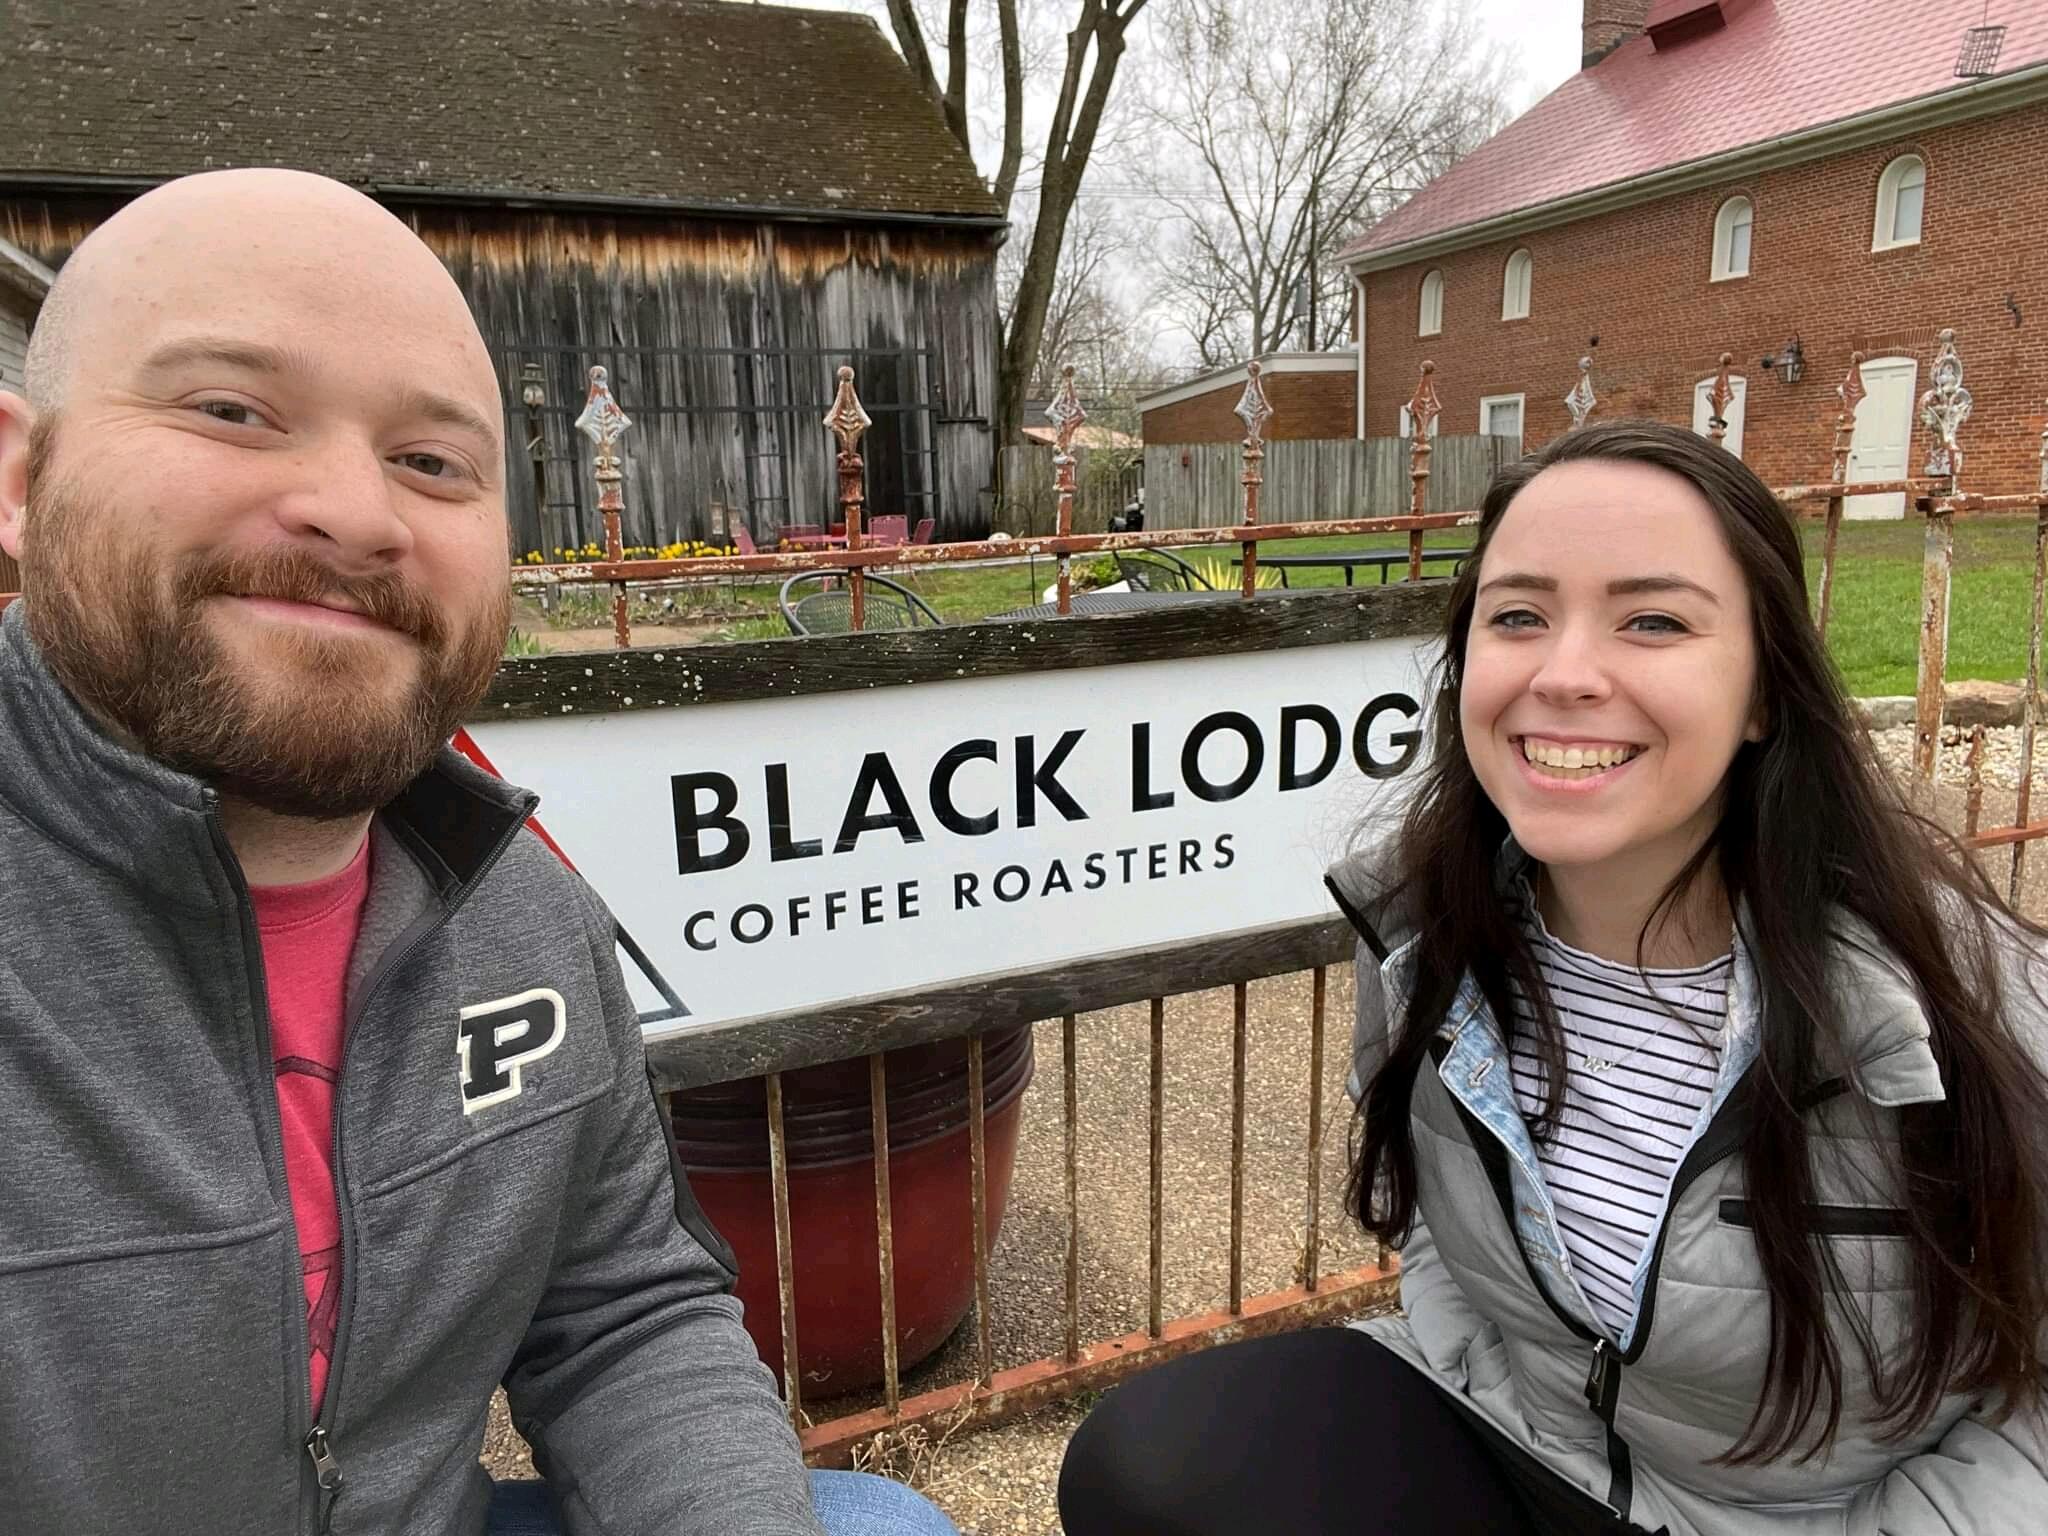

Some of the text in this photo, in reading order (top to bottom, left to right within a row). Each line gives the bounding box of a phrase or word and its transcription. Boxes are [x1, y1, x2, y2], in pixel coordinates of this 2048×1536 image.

[670, 692, 1424, 876] BLACK LODG
[683, 832, 1236, 952] COFFEE ROASTERS
[457, 987, 567, 1116] P
